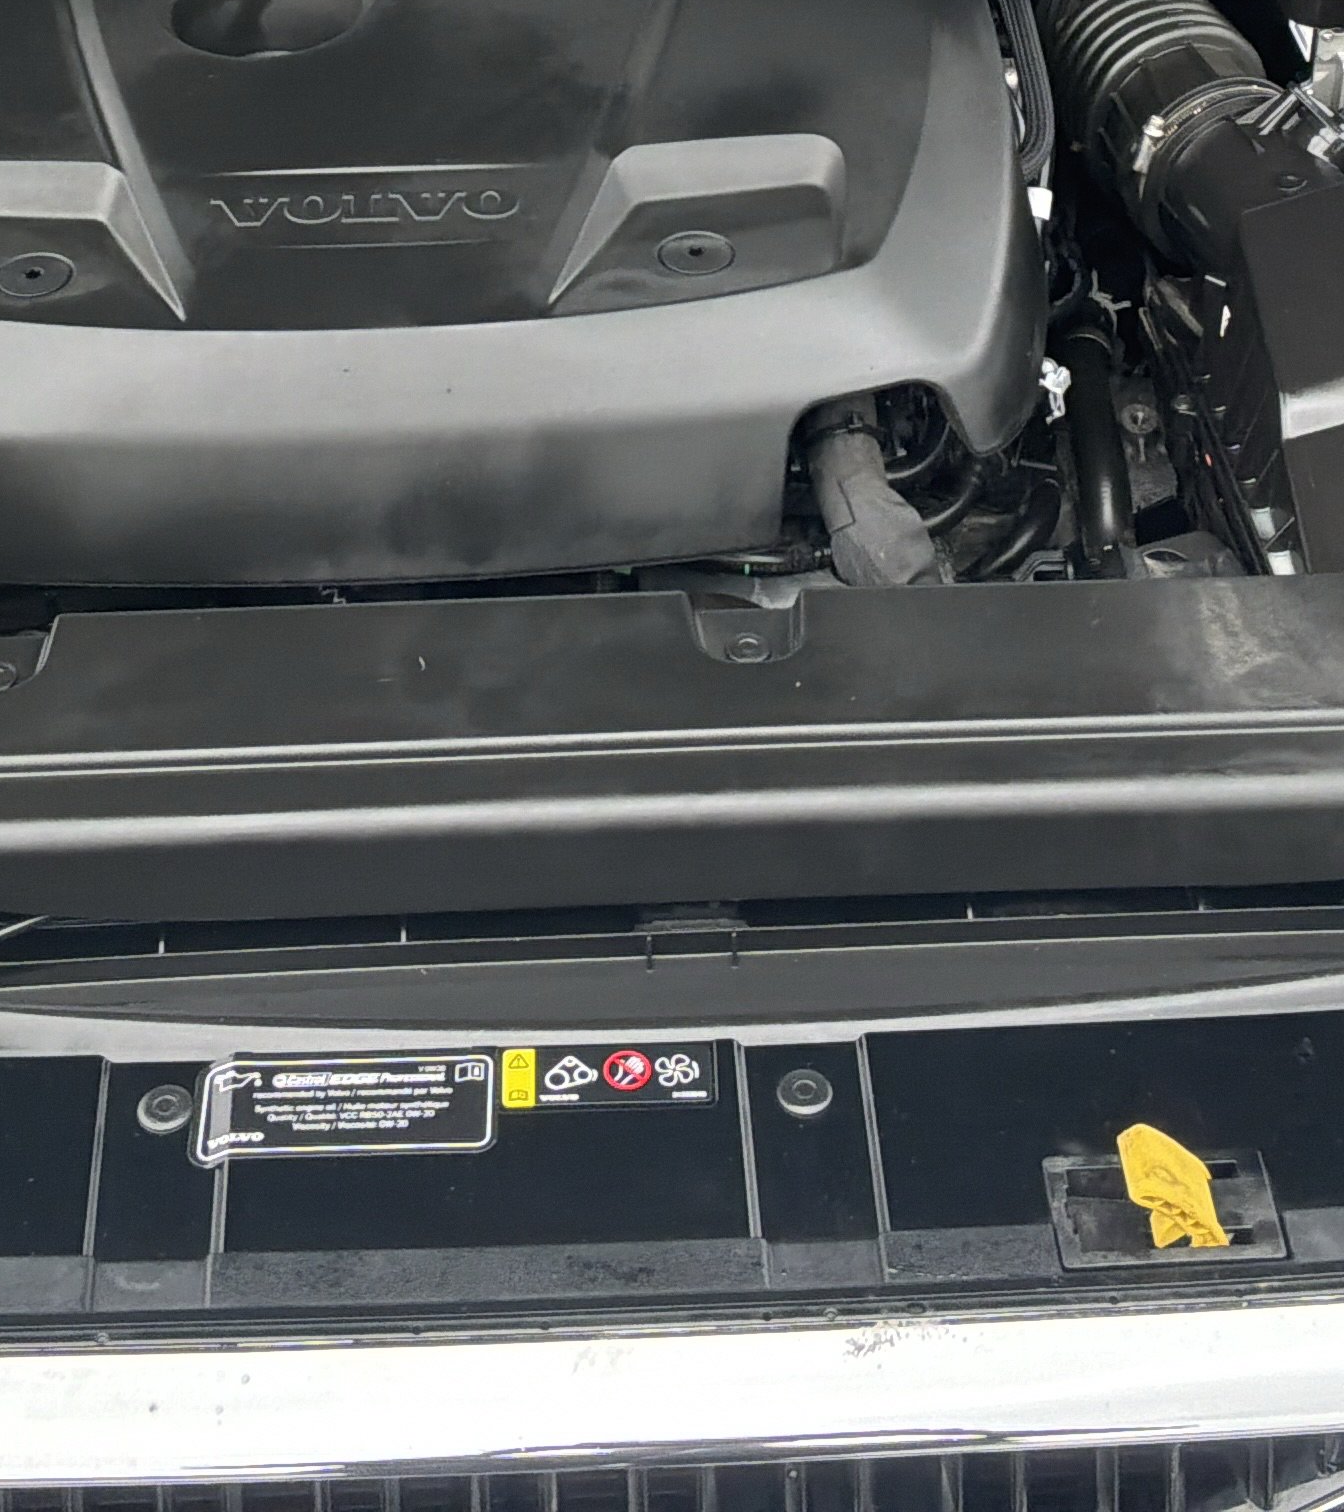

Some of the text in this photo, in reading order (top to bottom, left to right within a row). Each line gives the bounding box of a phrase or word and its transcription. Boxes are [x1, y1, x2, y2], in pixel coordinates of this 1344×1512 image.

[209, 189, 521, 228] VOLVO
[286, 1073, 328, 1087] Castrol
[207, 1131, 265, 1149] VOLVO
